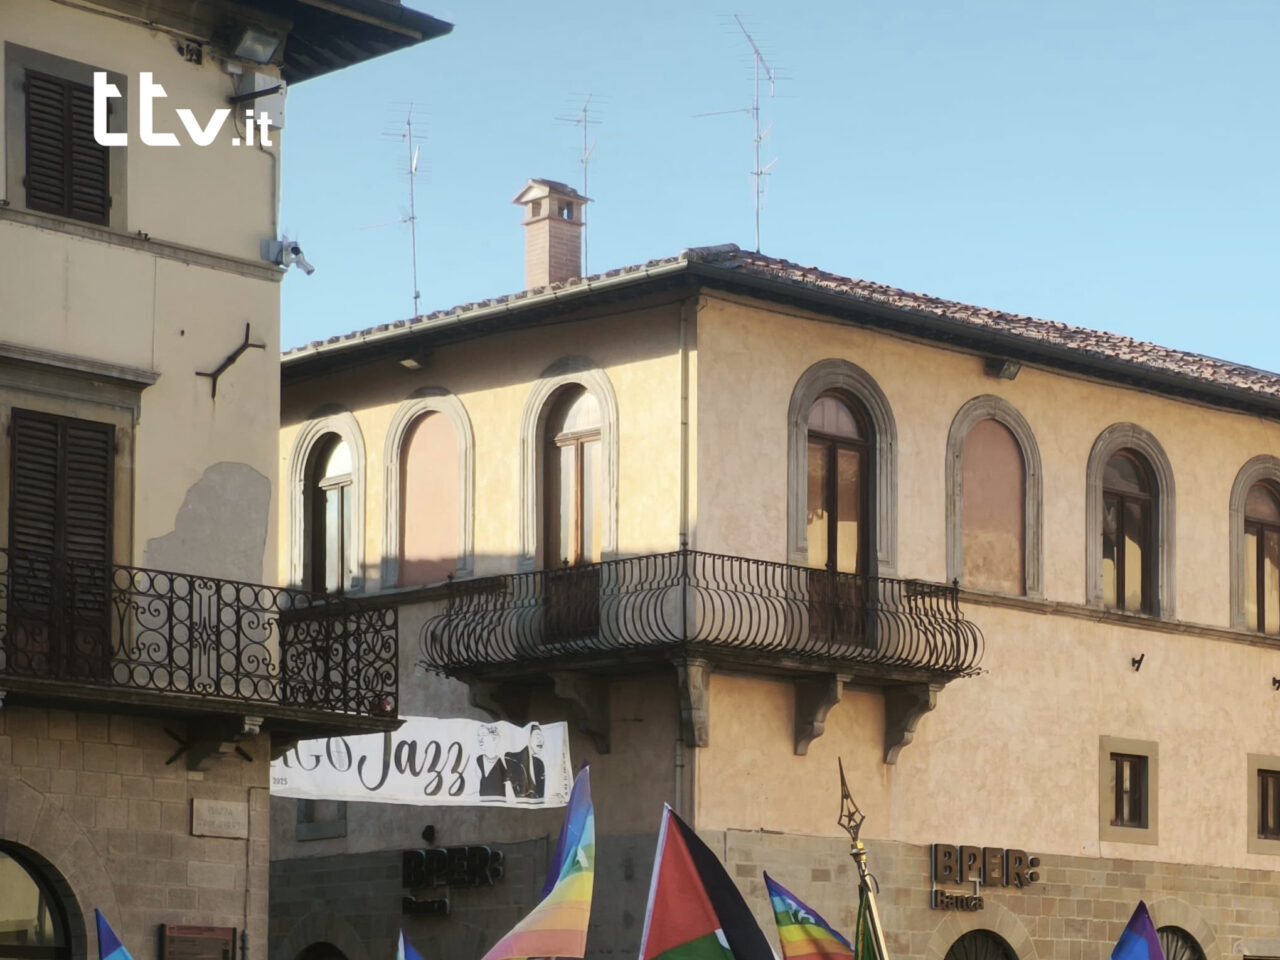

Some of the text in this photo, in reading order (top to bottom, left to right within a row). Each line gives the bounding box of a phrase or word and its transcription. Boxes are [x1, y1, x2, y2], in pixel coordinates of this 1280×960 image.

[357, 731, 471, 797] Jazz
[272, 776, 289, 787] 2025
[931, 889, 985, 912] Banca
